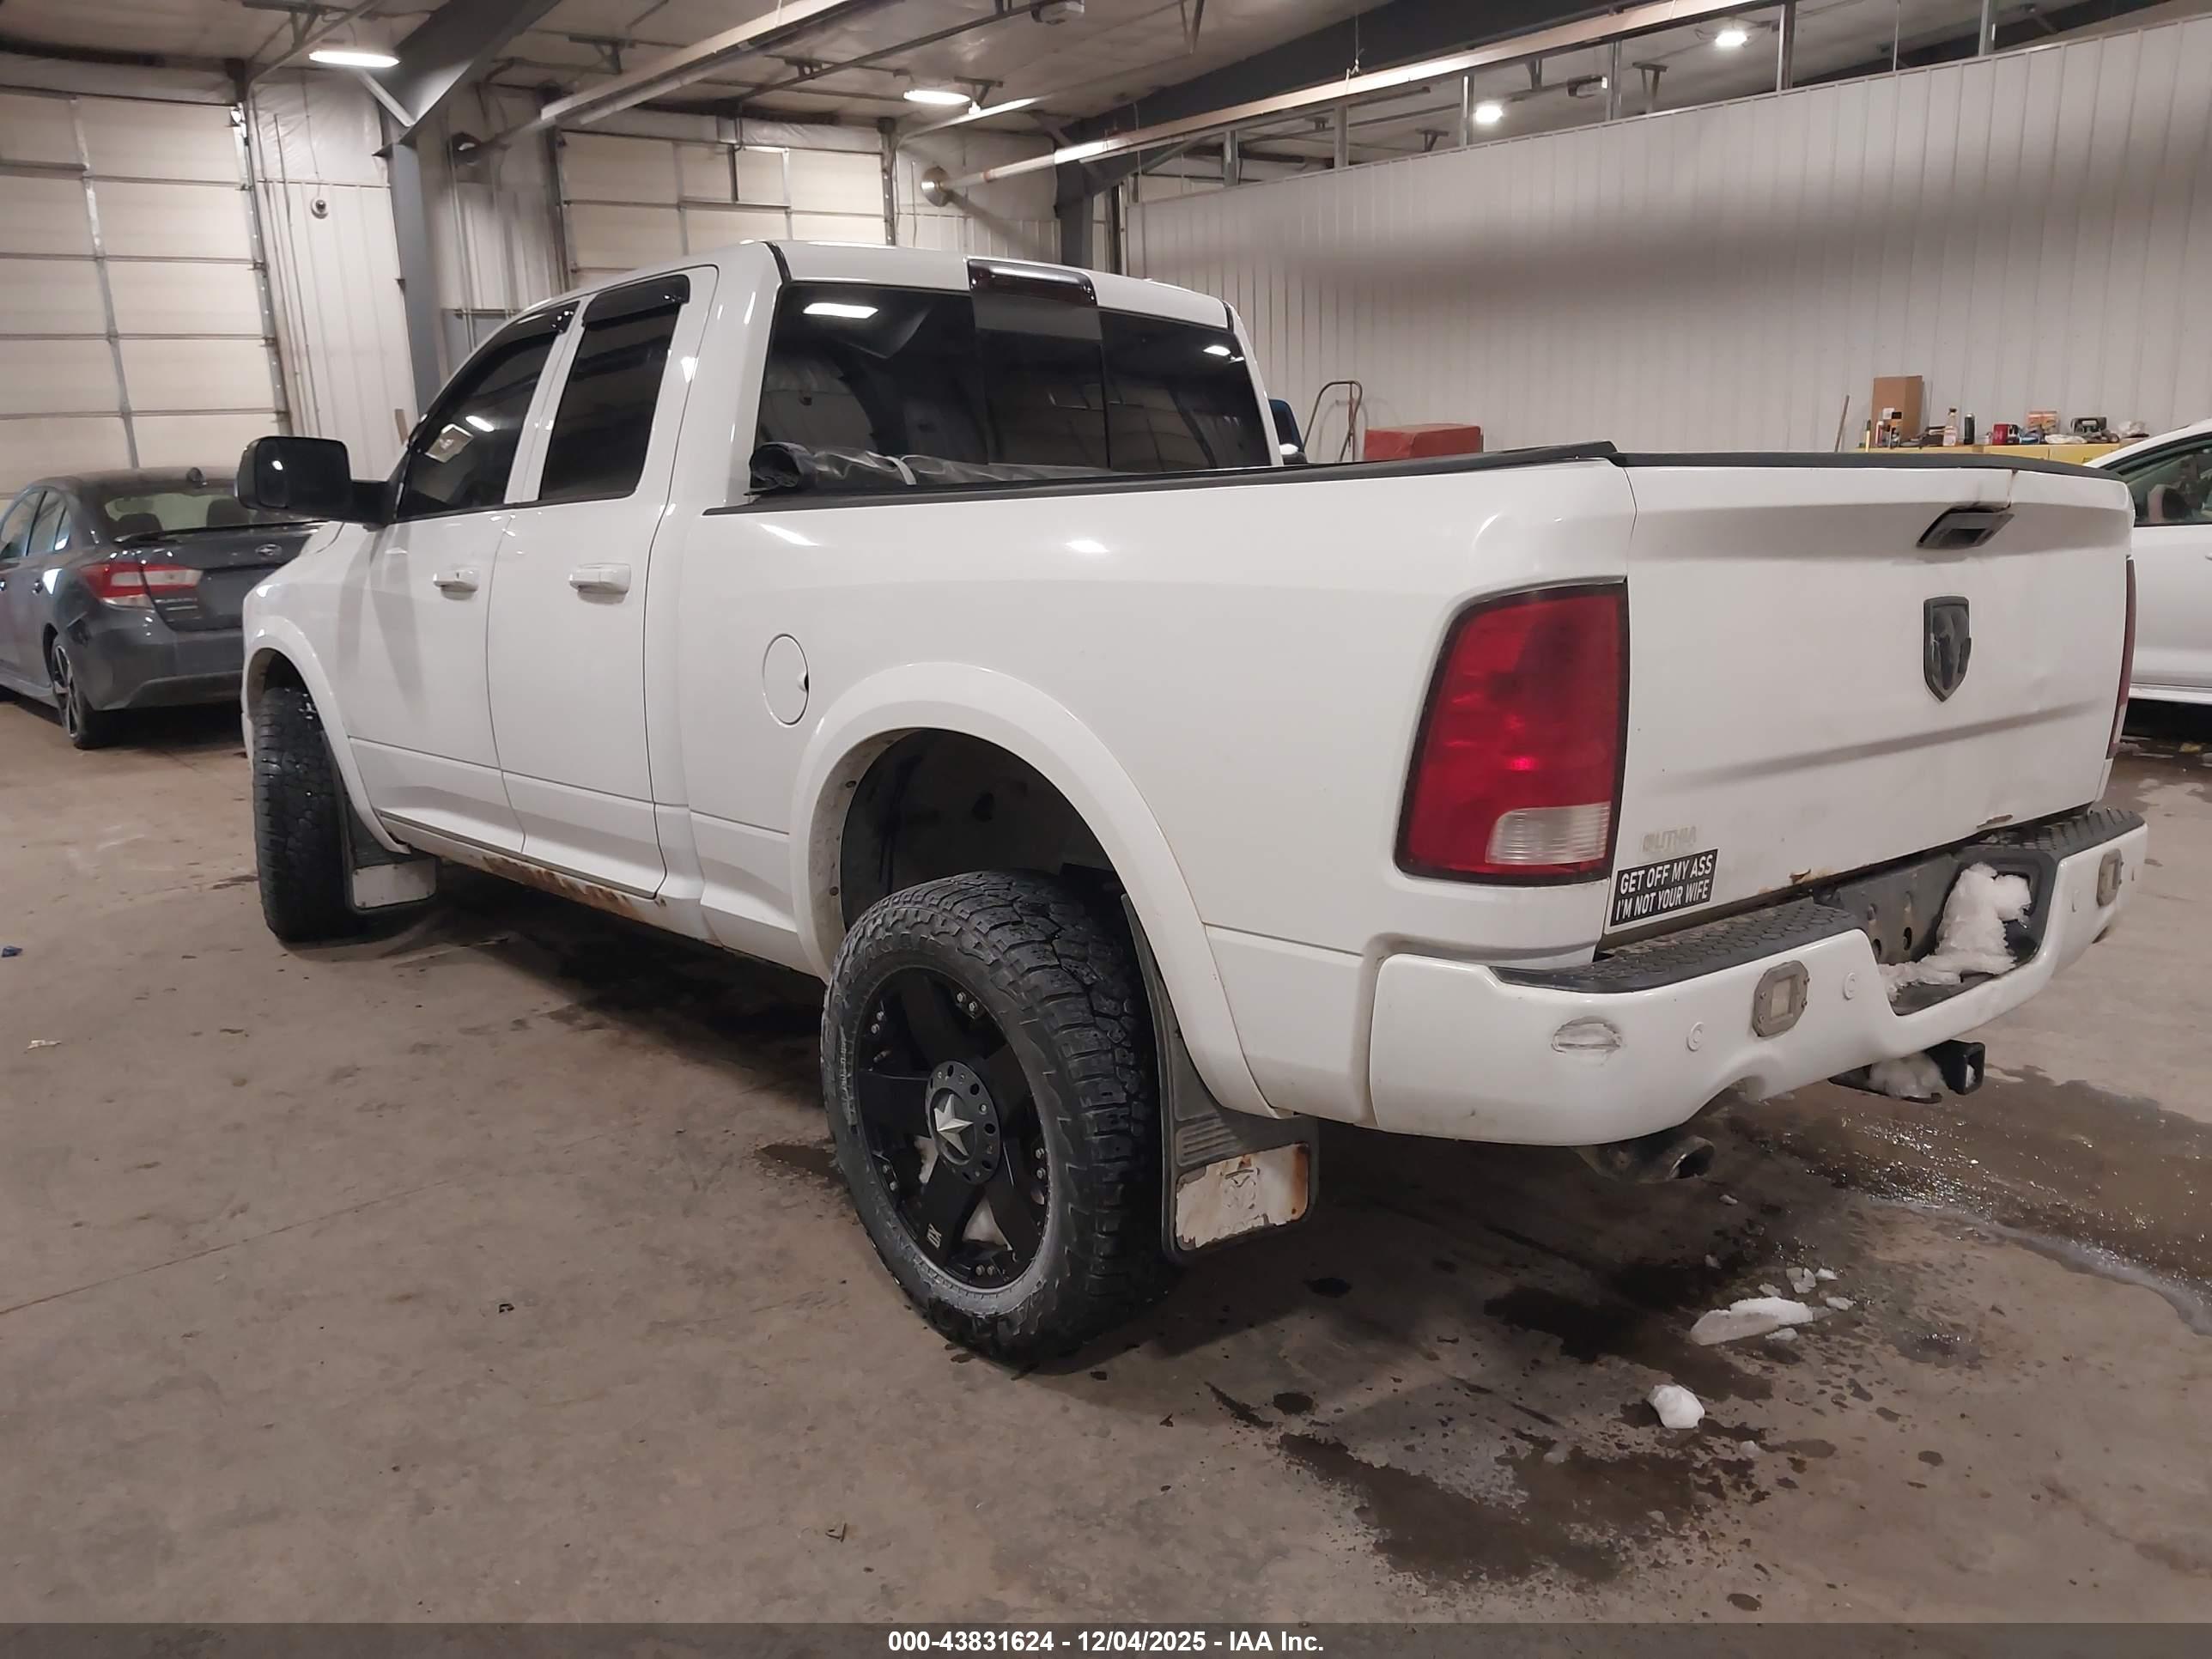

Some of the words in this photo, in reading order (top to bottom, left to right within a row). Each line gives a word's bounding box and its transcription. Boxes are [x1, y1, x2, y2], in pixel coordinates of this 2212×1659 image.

[1620, 870, 1644, 895] GET
[1647, 864, 1670, 888] OFF
[1672, 860, 1690, 882] MY
[1690, 854, 1713, 878] ASS
[1616, 898, 1632, 921] I'M
[1634, 892, 1656, 916] NOT
[1657, 885, 1683, 909] YOUR
[1685, 879, 1710, 903] WIFE
